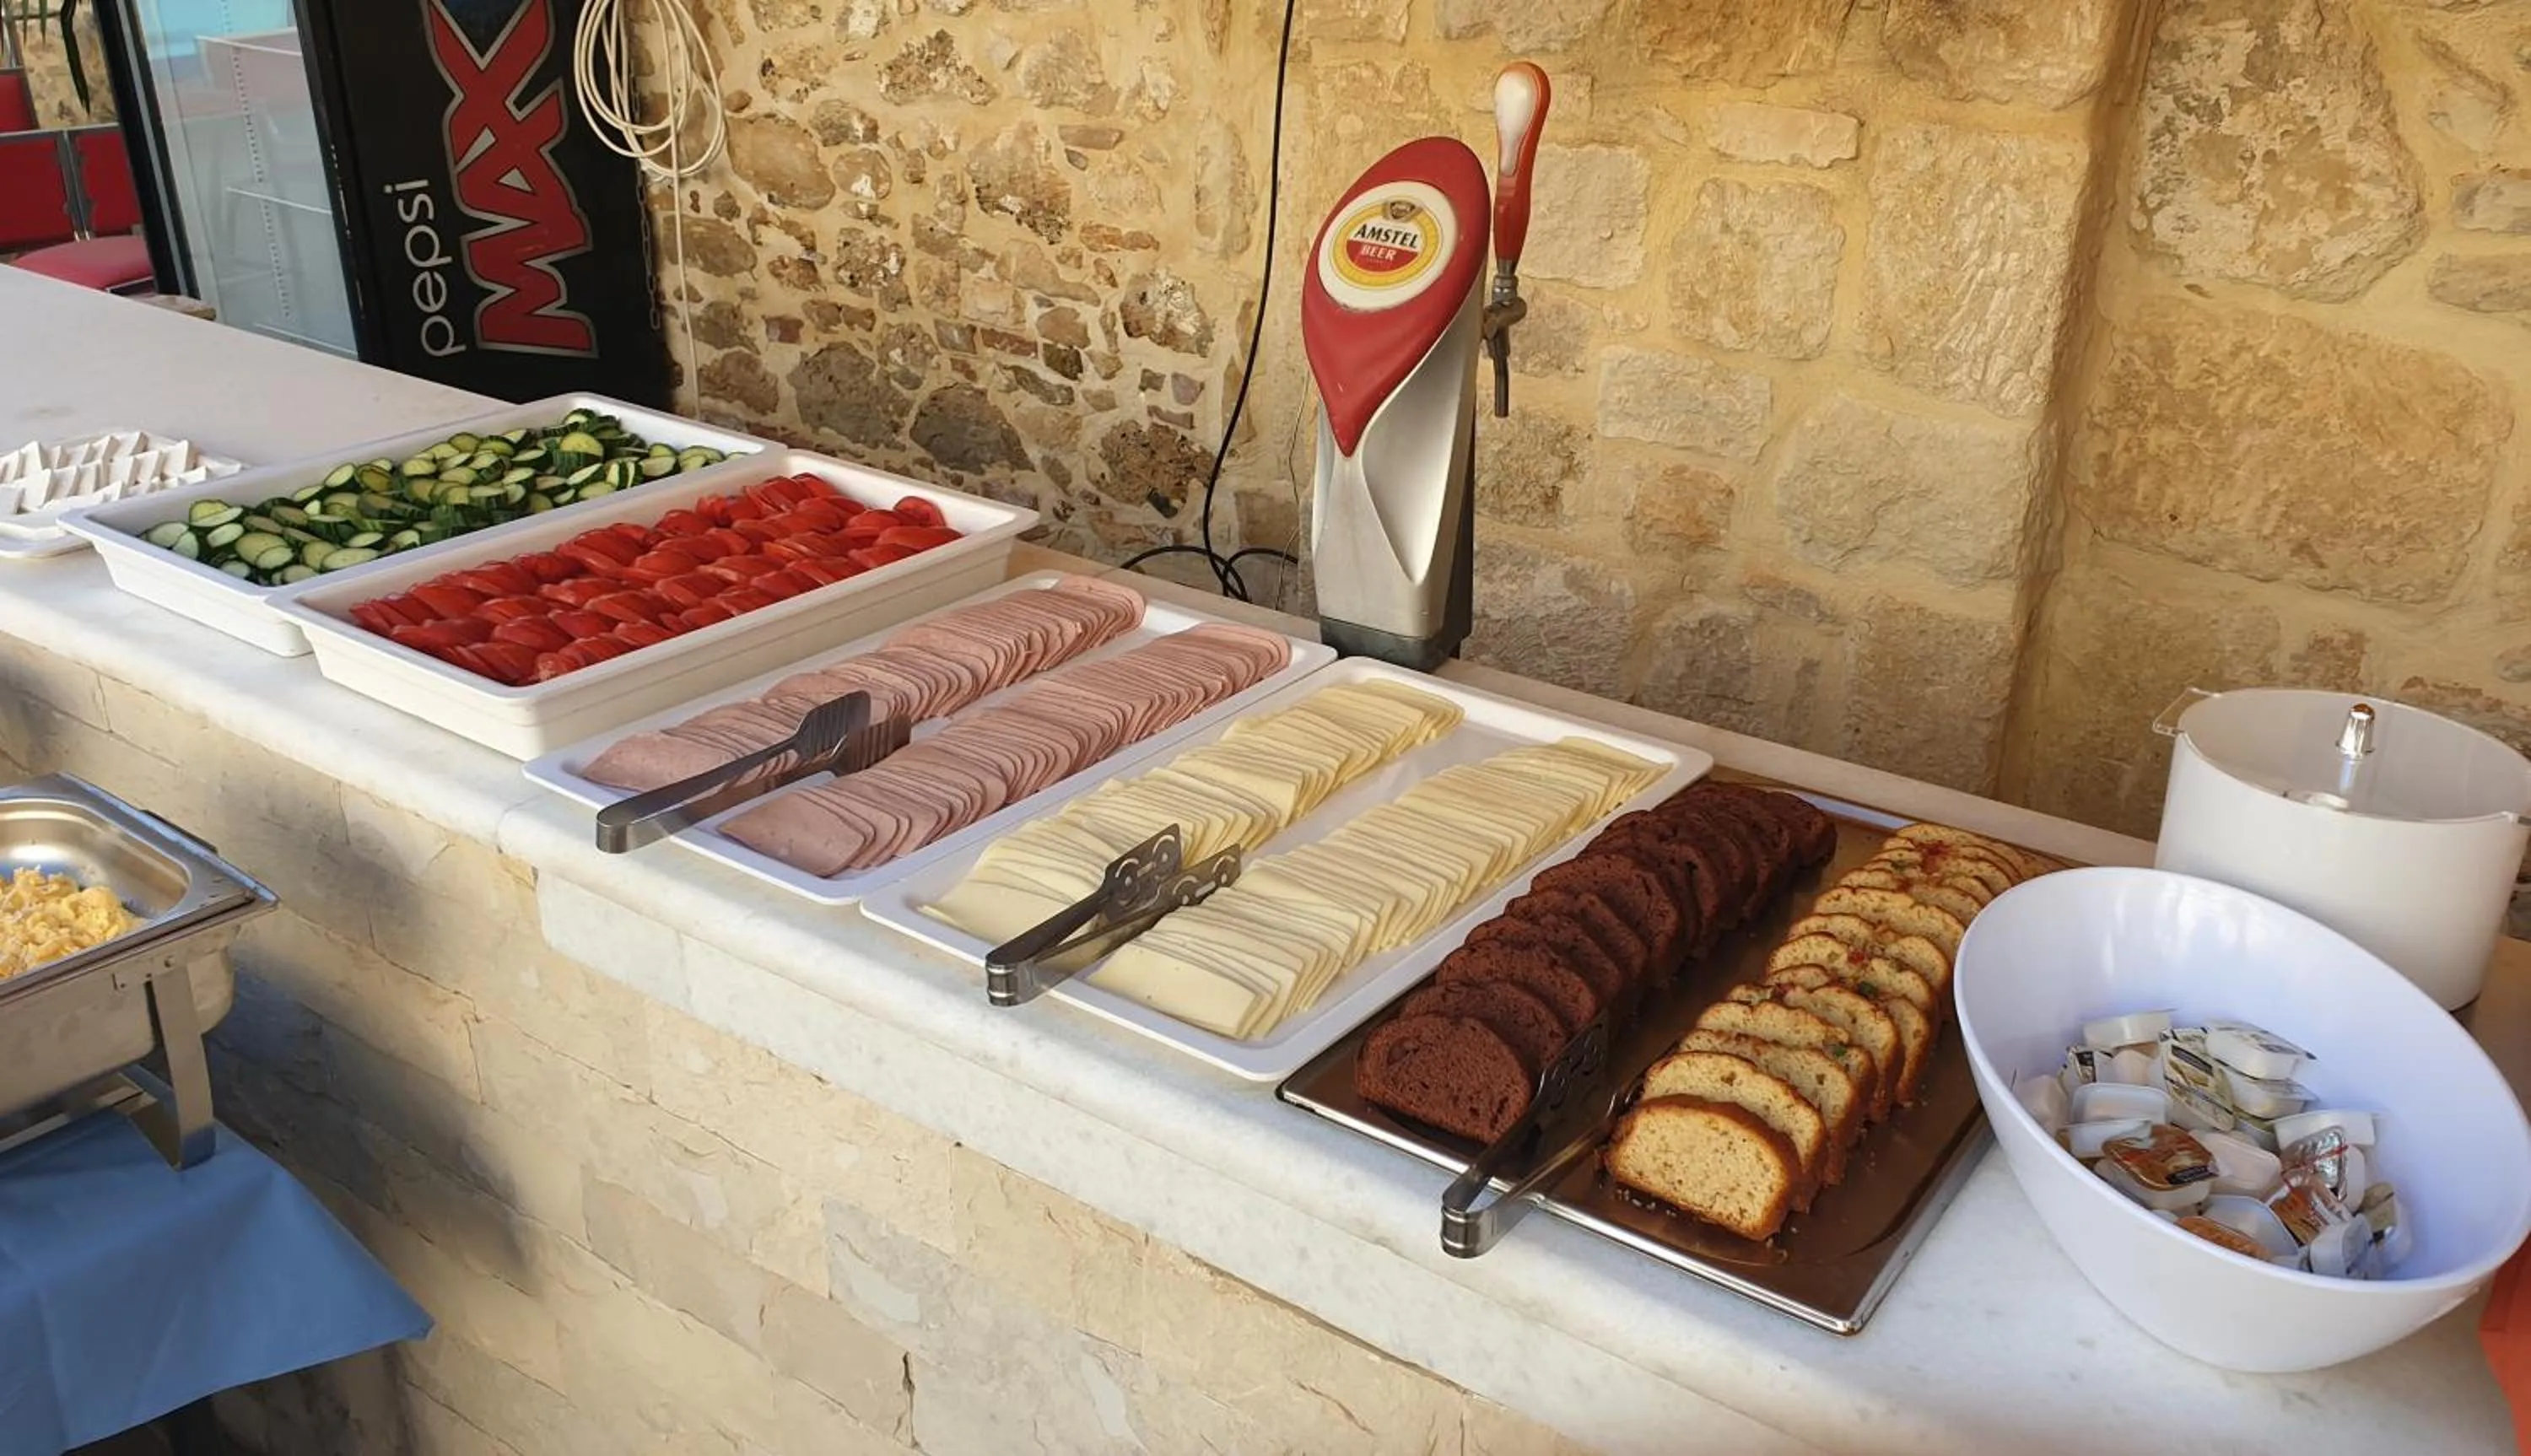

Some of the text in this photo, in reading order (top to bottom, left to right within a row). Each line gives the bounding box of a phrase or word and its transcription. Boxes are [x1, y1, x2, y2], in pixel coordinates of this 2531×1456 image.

[422, 0, 598, 358] MAX
[383, 179, 466, 357] pepsi
[1353, 223, 1419, 249] AMSTEL
[1361, 244, 1397, 261] BEER
